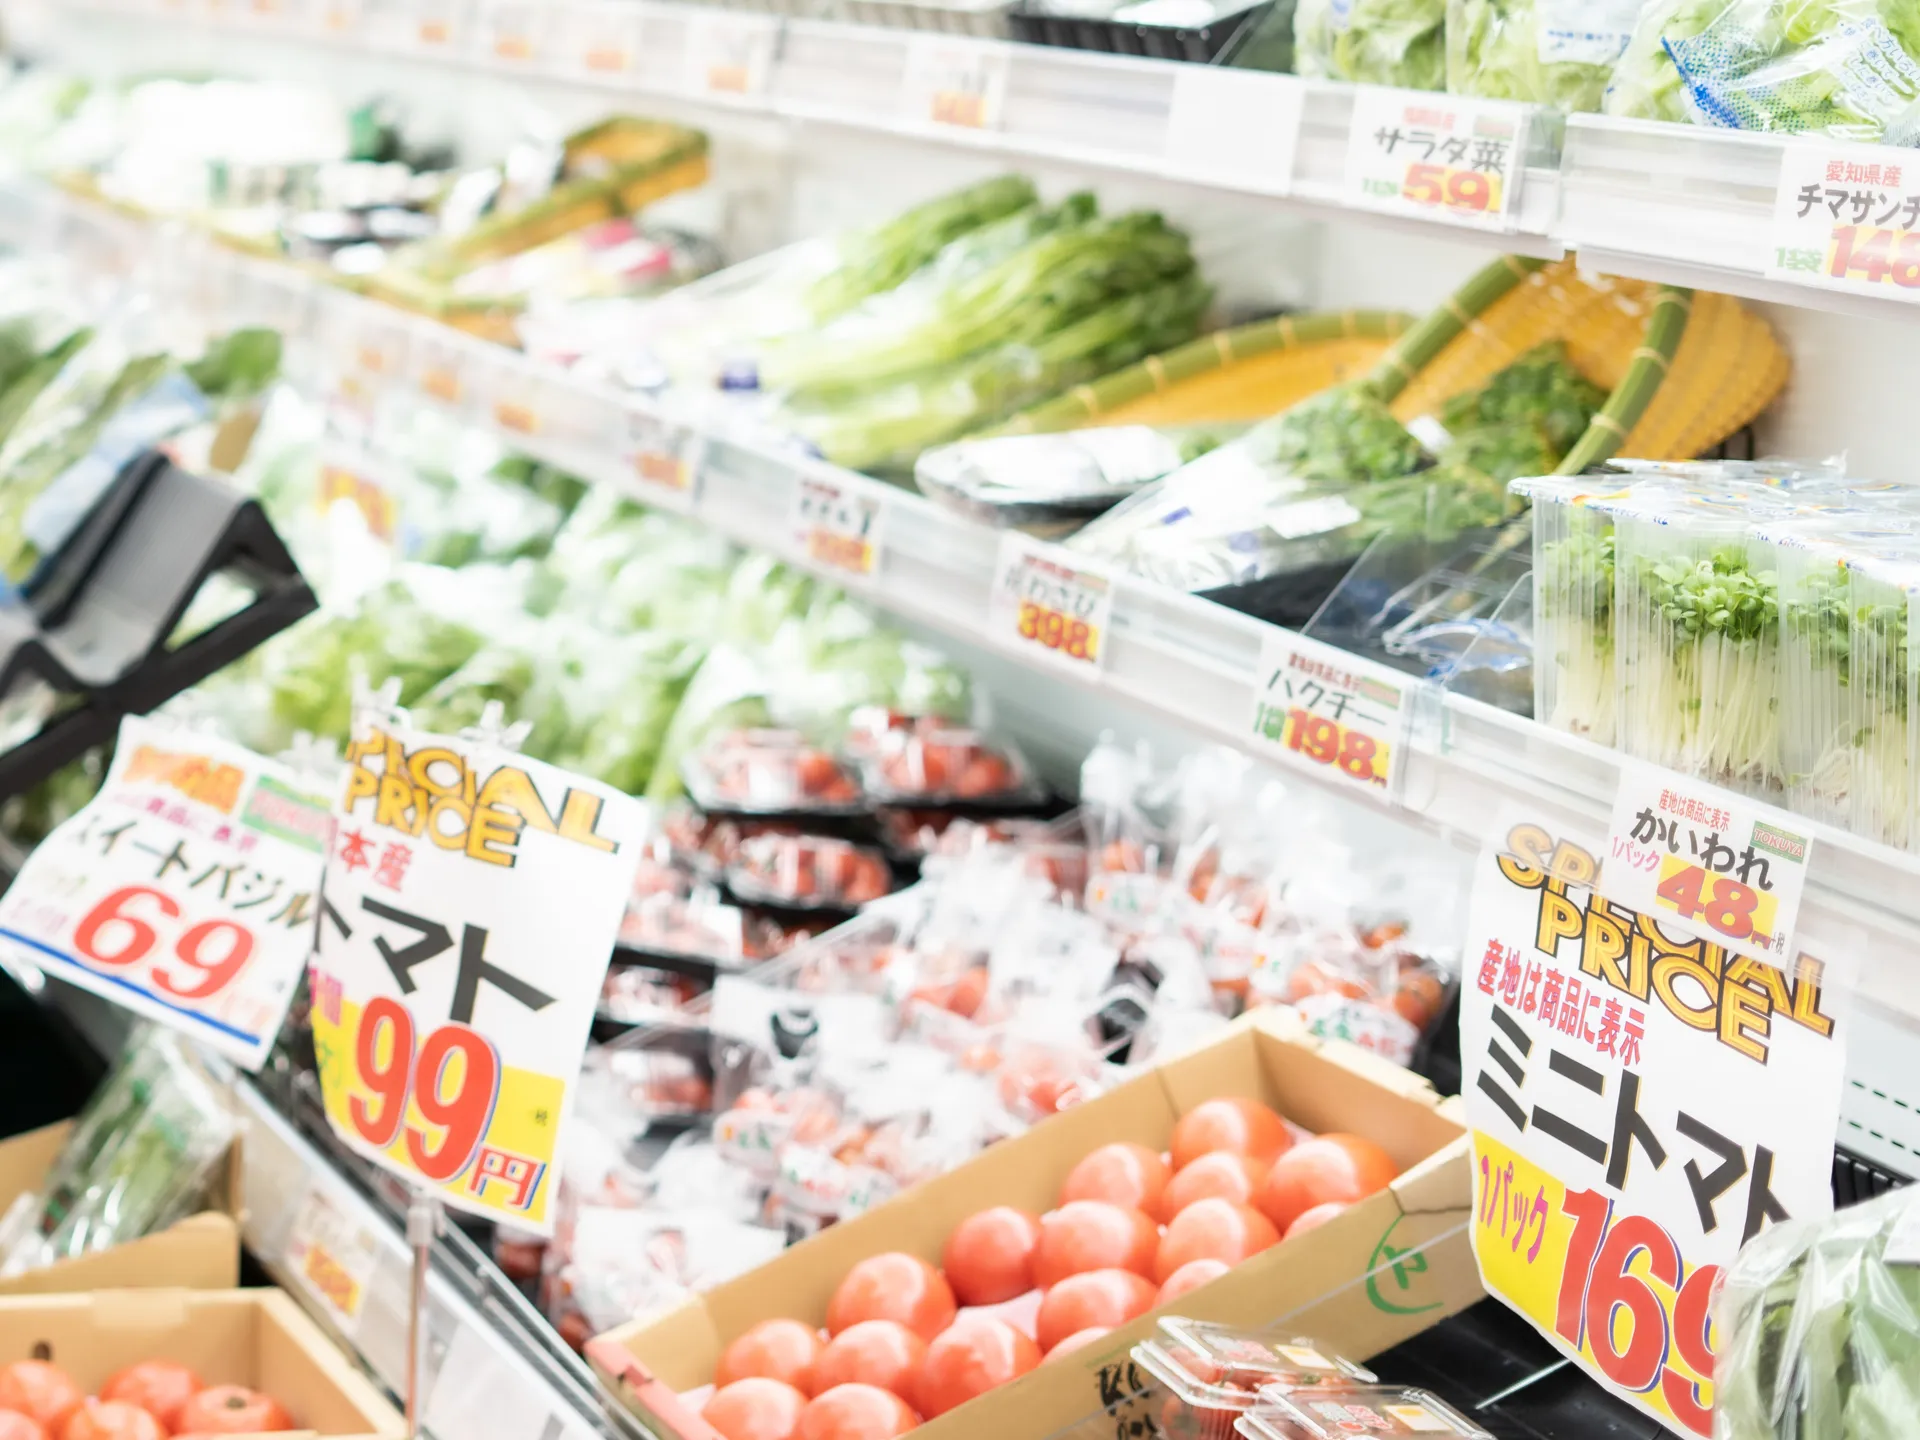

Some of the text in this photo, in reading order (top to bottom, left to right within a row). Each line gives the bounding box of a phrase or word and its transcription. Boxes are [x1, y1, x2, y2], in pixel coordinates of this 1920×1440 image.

[1374, 127, 1510, 174] サラダ菜
[1402, 163, 1491, 212] 59
[1825, 160, 1902, 188] 愛知県産
[344, 763, 519, 868] PRICE
[1630, 807, 1774, 891] かいわれ
[1658, 788, 1731, 832] 産地は商品に表示
[1752, 828, 1805, 858] TOKUYA
[330, 818, 414, 893] 本産
[73, 885, 257, 999] 69
[313, 868, 561, 1026] トマト
[1535, 889, 1771, 1067] PRICE
[1476, 937, 1646, 1067] 産地は商品に表示
[1476, 1005, 1793, 1251] ミニトマト
